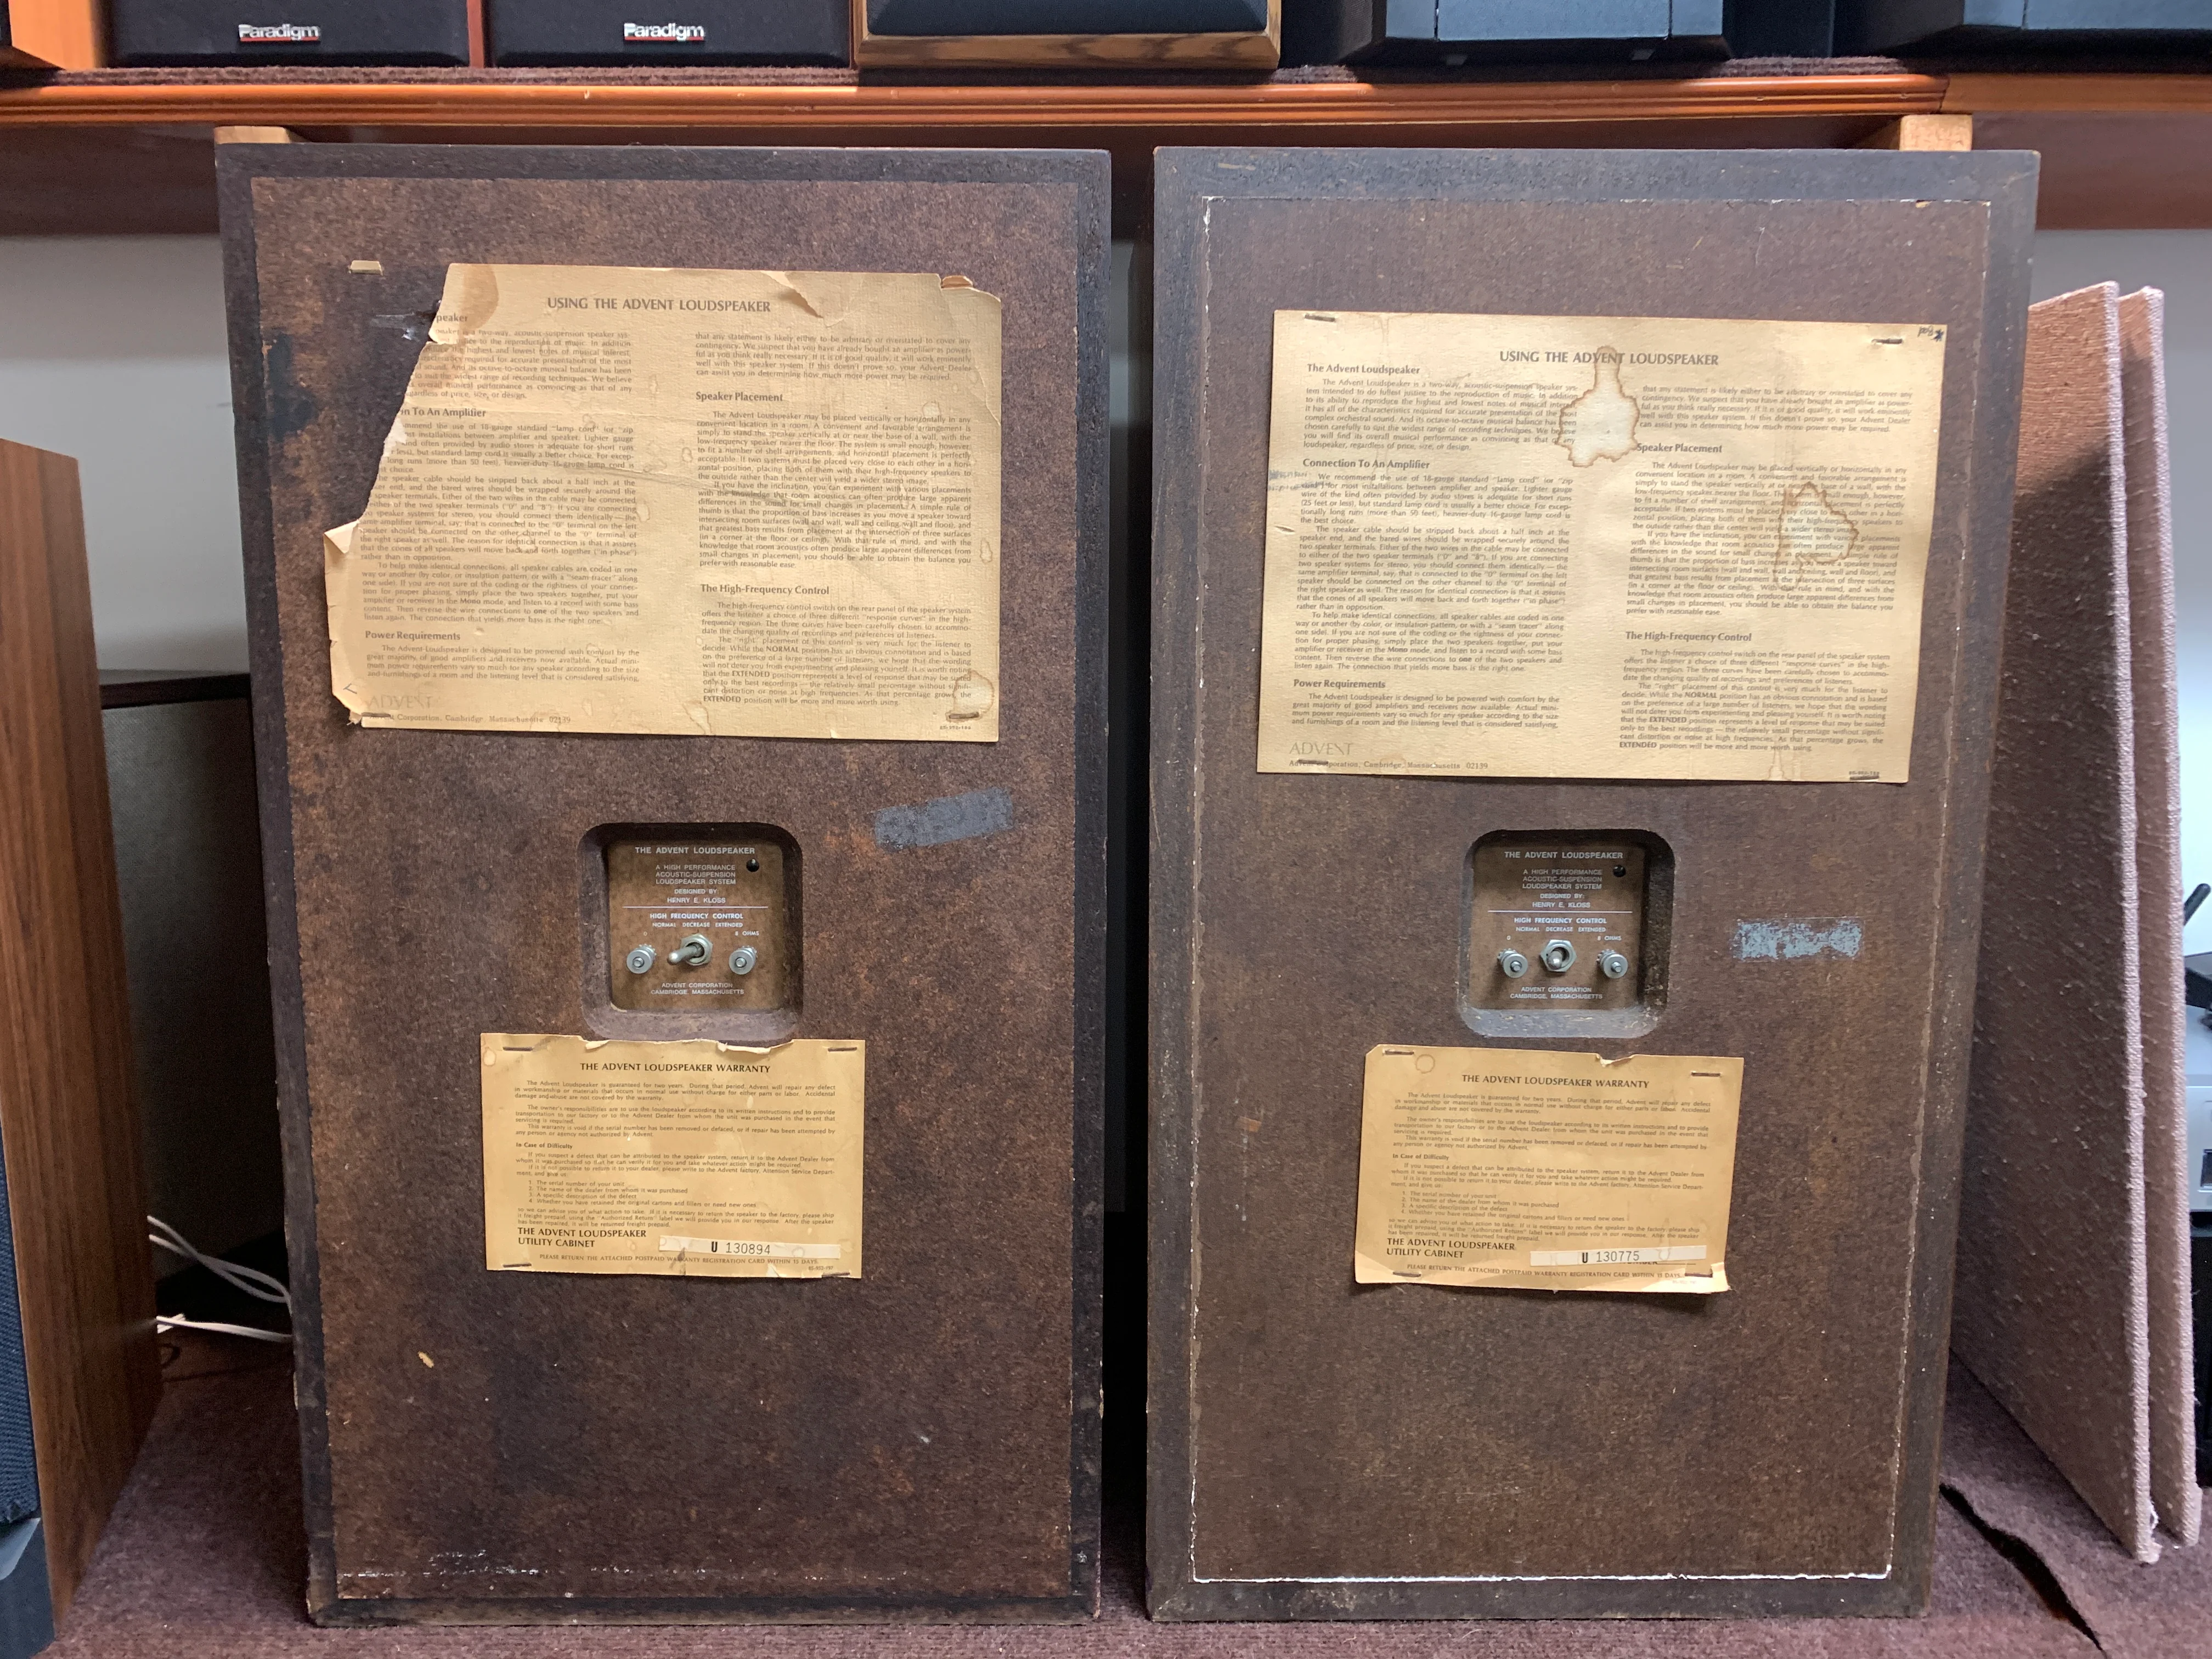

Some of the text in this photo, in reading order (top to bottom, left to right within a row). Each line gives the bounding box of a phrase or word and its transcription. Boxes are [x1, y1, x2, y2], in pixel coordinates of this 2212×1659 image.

[239, 24, 321, 41] Paradigm
[624, 22, 704, 41] Paradigm
[548, 297, 771, 312] USING THE ADVENT LOUDSPEAKER
[1499, 351, 1719, 365] USING THE ADVENT LOUDSPEAKER
[1307, 363, 1420, 376] The Advent Loudspeaker
[696, 391, 783, 402] Speaker Placement
[413, 407, 425, 416] To
[427, 408, 440, 416] An
[442, 408, 487, 419] Amplifier
[1637, 443, 1722, 454] Speaker Placement
[1302, 458, 1430, 471] Connection To An Amplifier
[700, 584, 830, 596] The High-Frequency Control
[365, 630, 461, 642] Power Requirements
[1625, 631, 1752, 643] The High-Frequency Control
[1294, 679, 1386, 690] Power Requirements
[1289, 741, 1354, 755] ADVENT
[1465, 761, 1488, 770] 02139
[602, 1063, 641, 1071] ADVENT
[645, 1063, 713, 1071] LOUDSPEAKER
[716, 1064, 770, 1073] WARRANTY
[1462, 1074, 1650, 1088] THE ADVENT LOUDSPEAKER WARRANTY
[517, 1227, 646, 1238] THE ADVENT LOUDSPEAKER
[518, 1237, 595, 1248] UTILITY CABINET
[711, 1241, 770, 1255] U 130894
[1407, 1238, 1446, 1248] ADVENT
[1449, 1240, 1515, 1249] LOUDSPEAKER
[1386, 1248, 1464, 1258] UTILITY CABINET
[1582, 1250, 1640, 1263] U 130775
